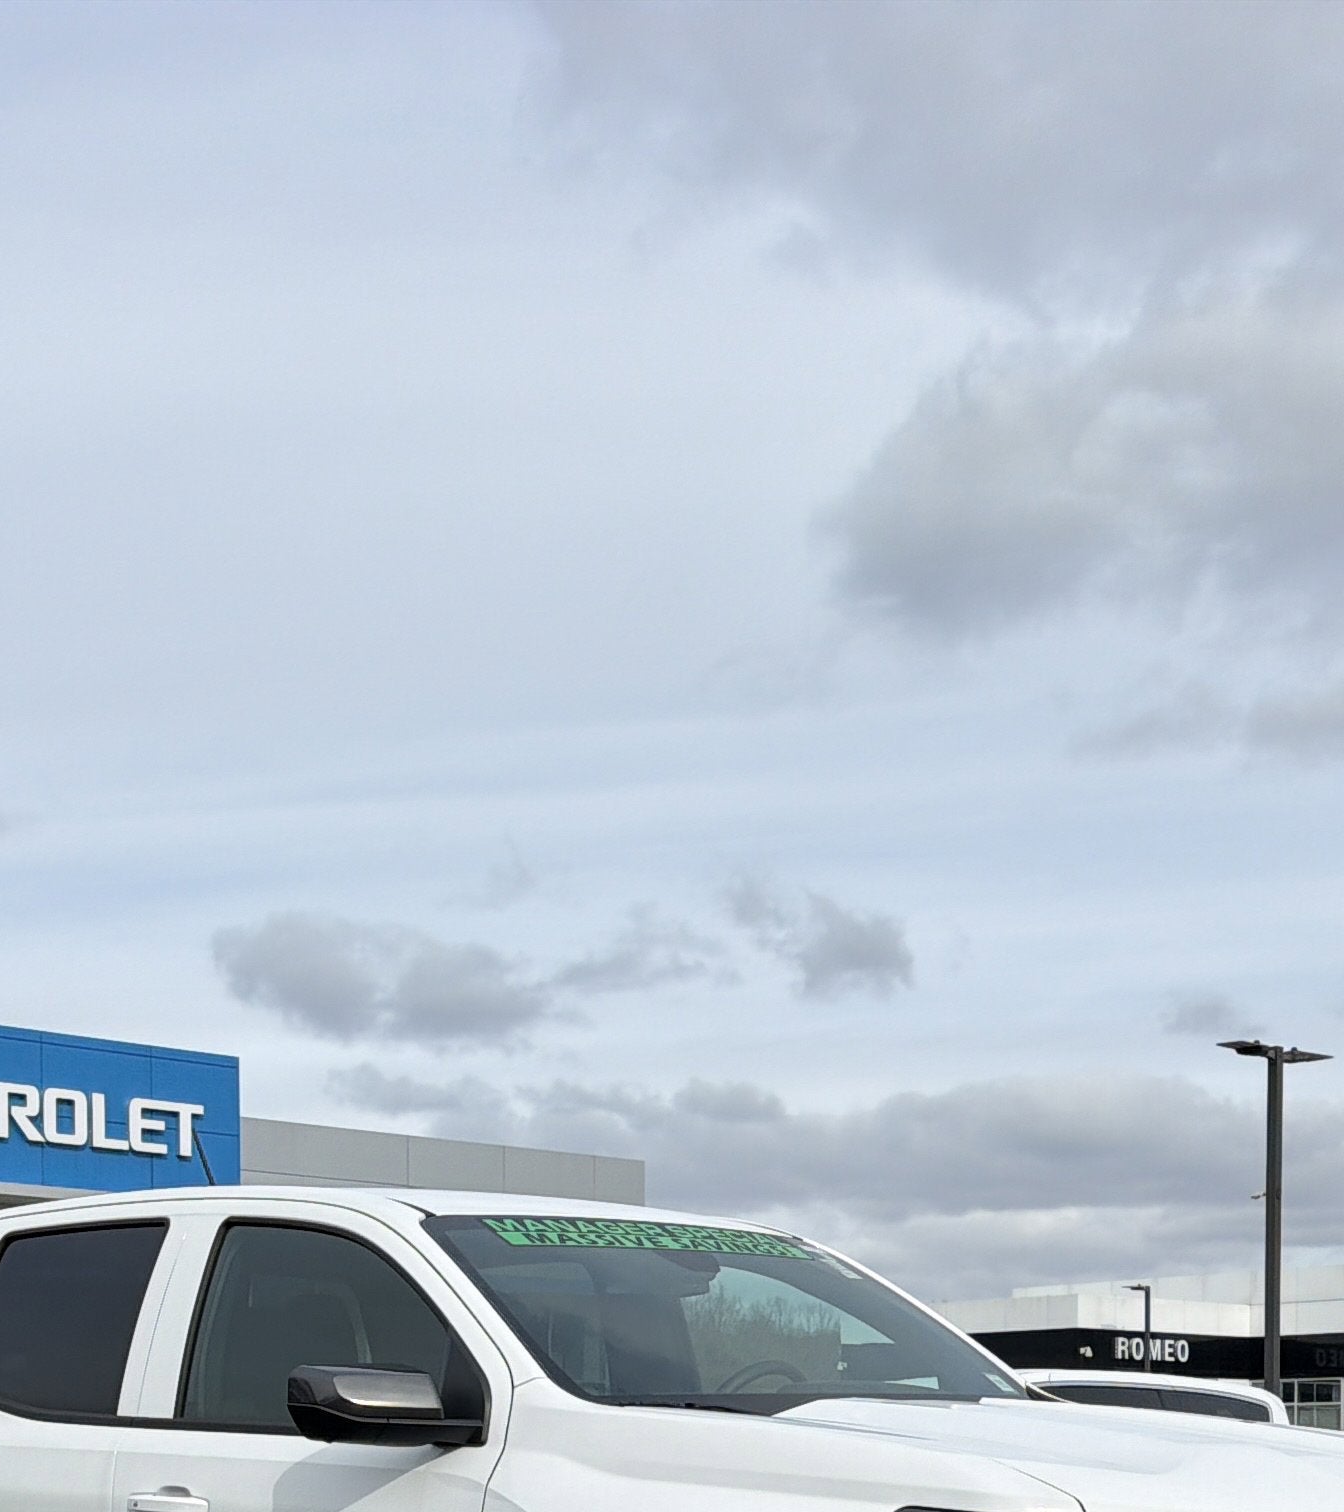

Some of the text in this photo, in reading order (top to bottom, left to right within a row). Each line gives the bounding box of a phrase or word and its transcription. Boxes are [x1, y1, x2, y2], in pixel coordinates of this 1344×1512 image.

[482, 1217, 663, 1235] MANAGER
[523, 1232, 664, 1248] MASSIVE
[1115, 1336, 1189, 1362] ROMEO
